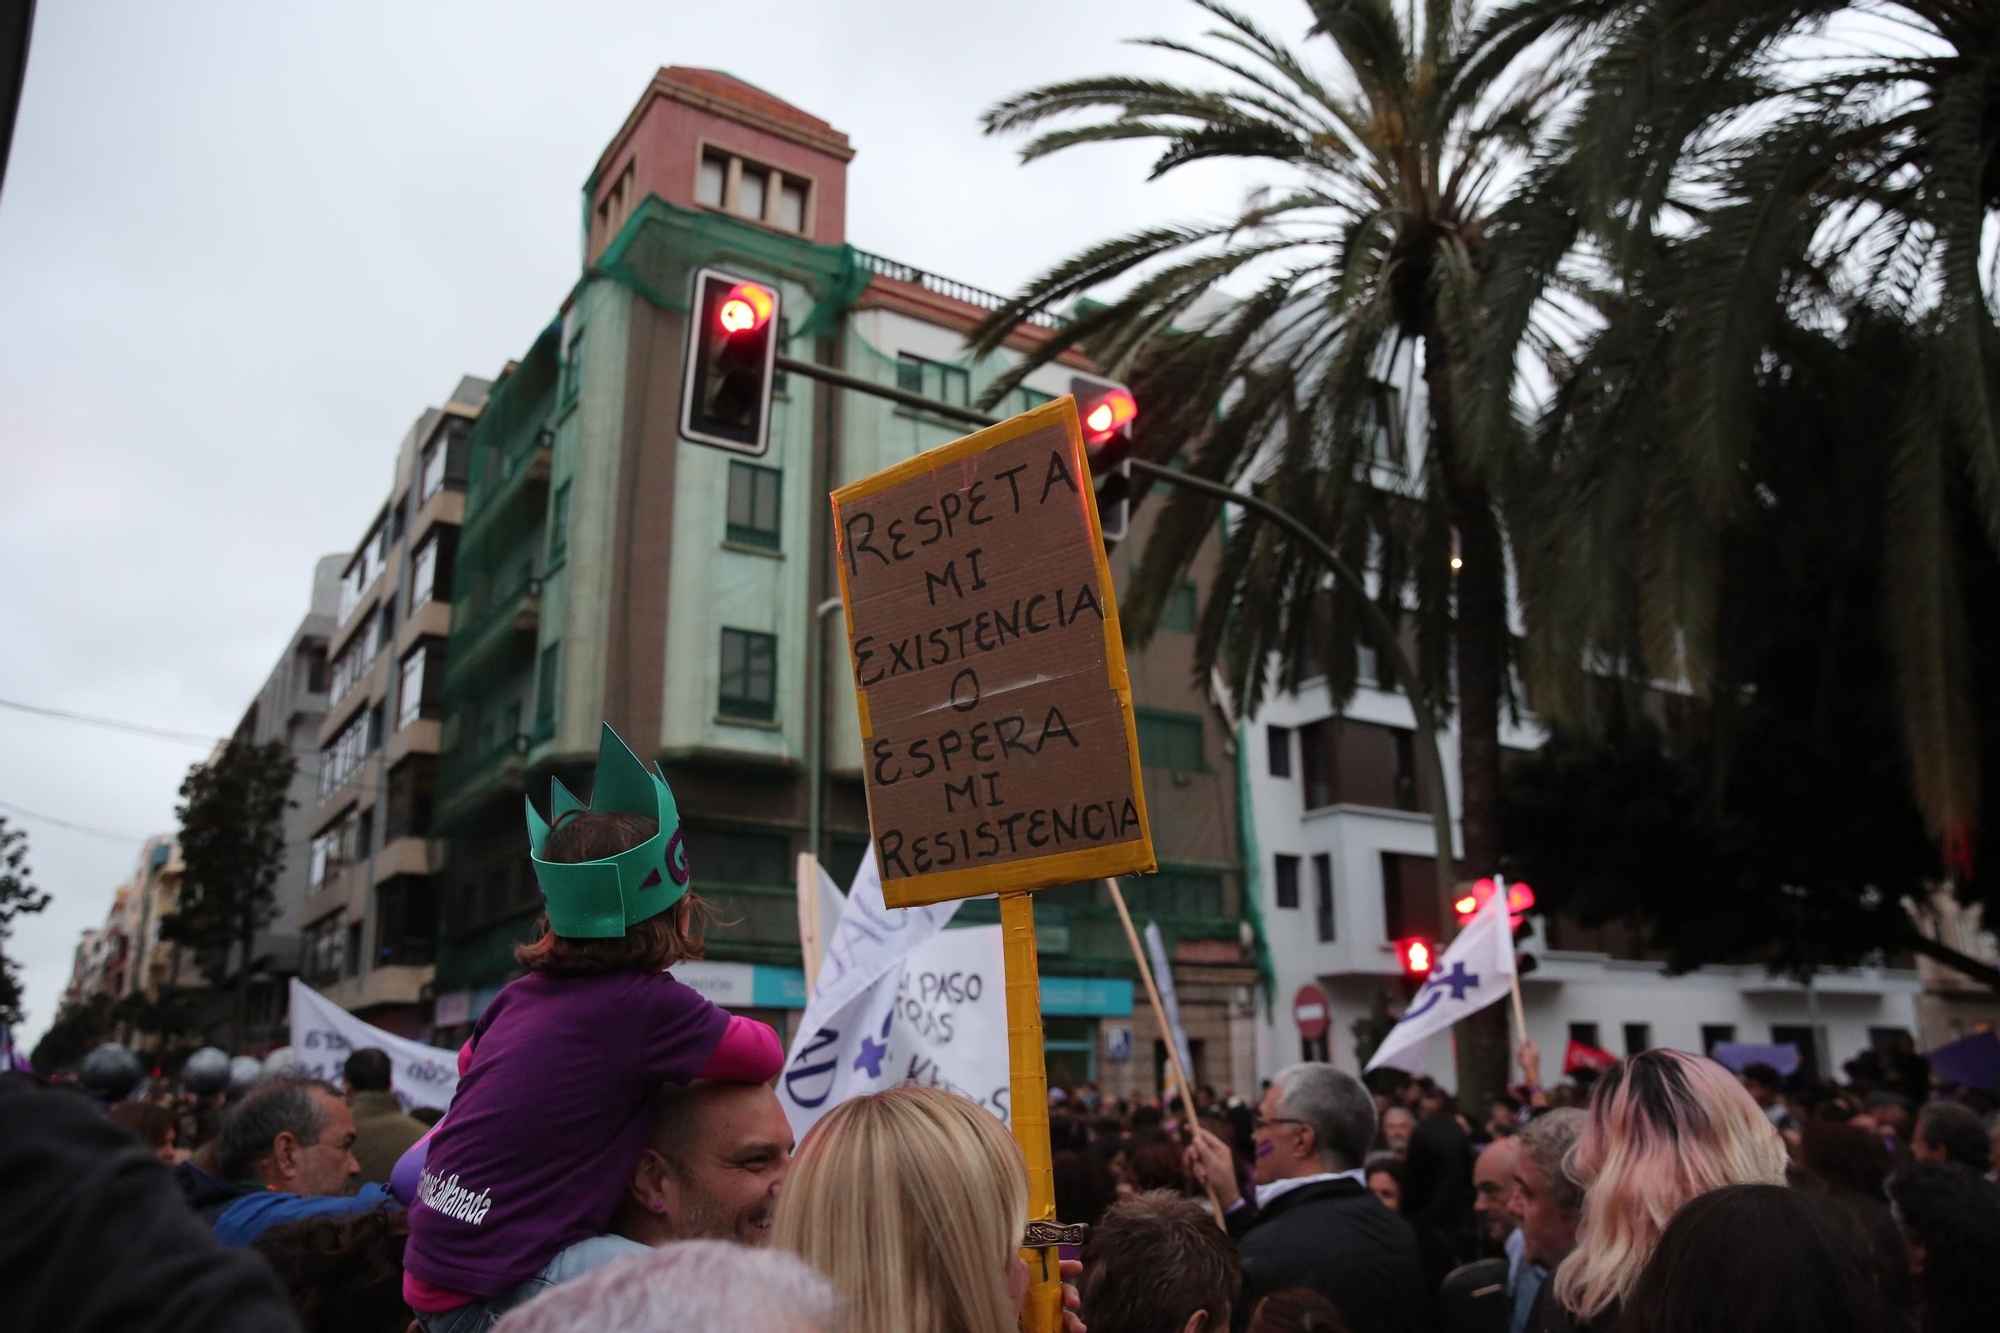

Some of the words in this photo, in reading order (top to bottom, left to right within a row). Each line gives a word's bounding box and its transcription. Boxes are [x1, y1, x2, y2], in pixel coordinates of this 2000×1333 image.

[845, 450, 1079, 576] RESPETA
[924, 547, 987, 606] MI
[855, 583, 1105, 687] EXISTENCIA
[950, 667, 980, 712] O
[873, 706, 1080, 785] ESPERA
[944, 773, 1004, 813] MI
[879, 798, 1140, 879] RESISTENCIA
[920, 971, 982, 1004] PASO
